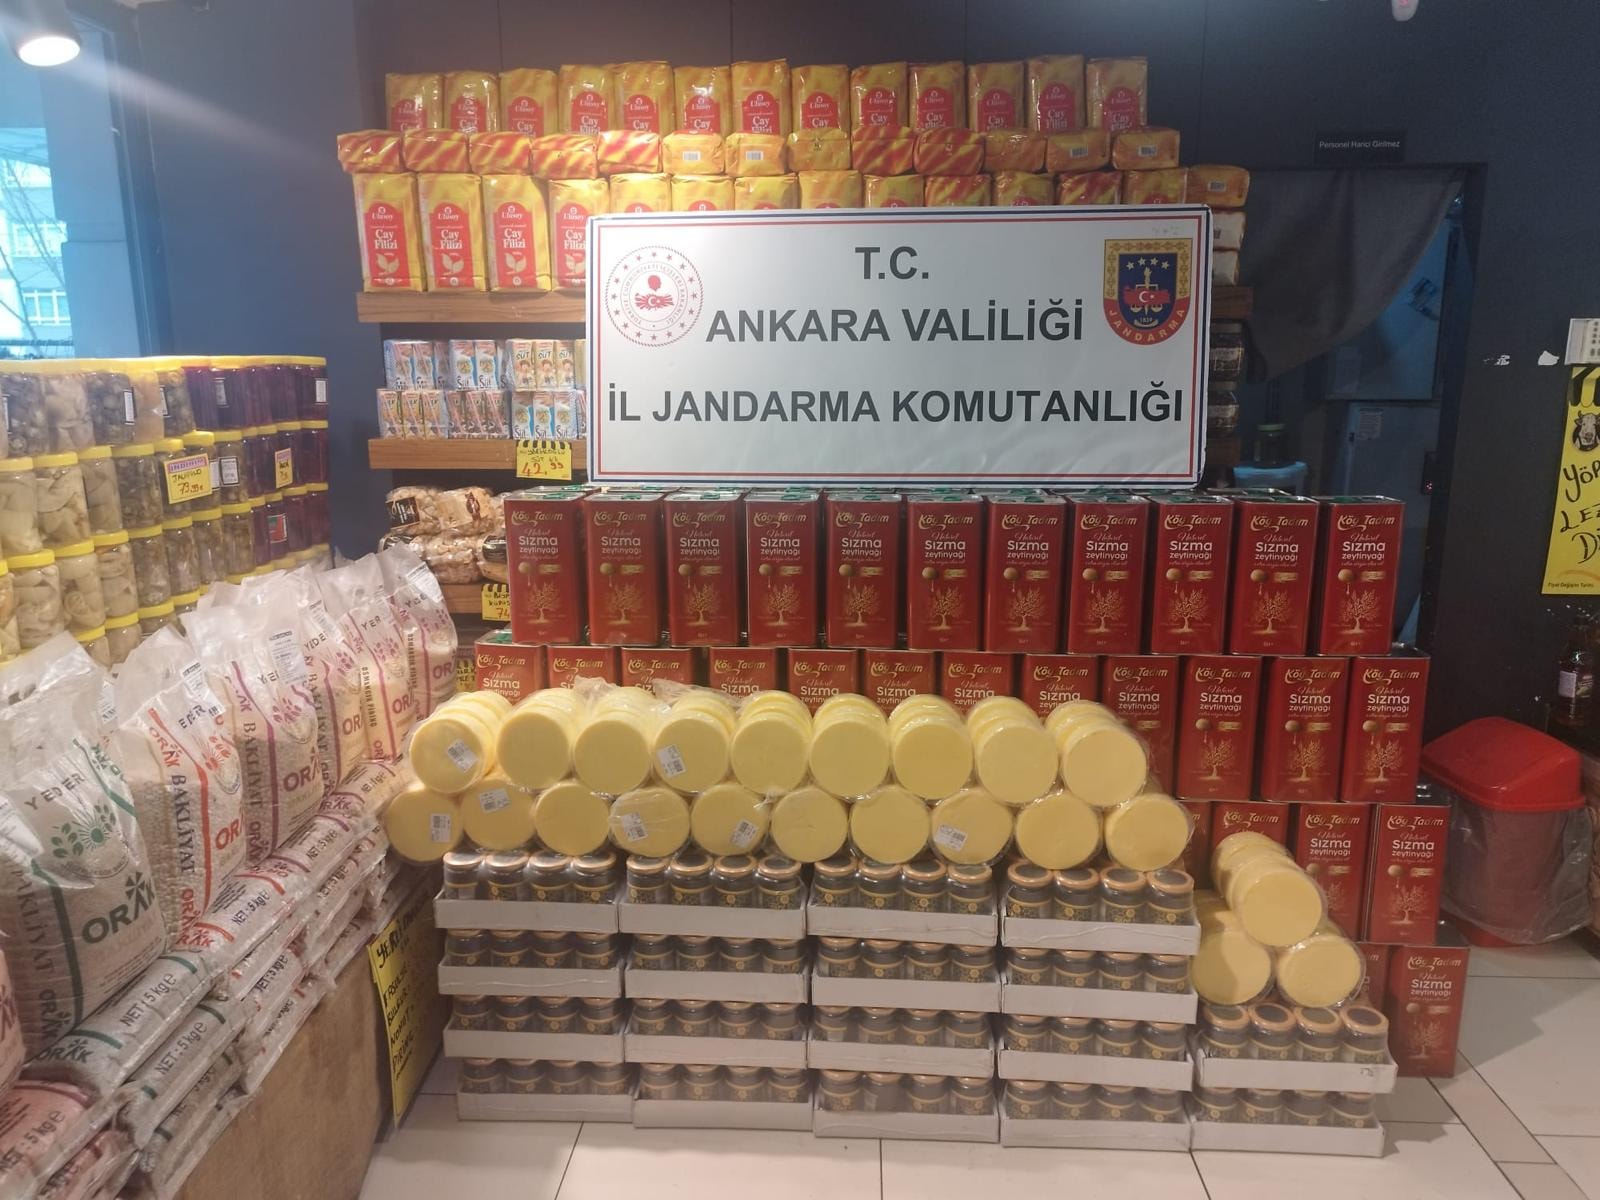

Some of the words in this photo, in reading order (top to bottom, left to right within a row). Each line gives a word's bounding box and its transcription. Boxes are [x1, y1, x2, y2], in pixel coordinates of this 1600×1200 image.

[375, 228, 393, 241] Çay
[441, 229, 459, 241] Çay
[504, 228, 522, 240] Çay
[565, 229, 584, 241] Çay
[374, 239, 398, 249] Filizi
[440, 239, 463, 249] Filizi
[503, 238, 526, 249] Filizi
[855, 246, 929, 280] T.C.
[705, 309, 891, 342] ANKARA
[901, 298, 1083, 342] VALİLİĞİ
[1109, 309, 1185, 342] JANDARMA
[609, 383, 641, 421] İL
[652, 390, 881, 422] JANDARMA
[892, 381, 1183, 422] KOMUTANLIĞI
[519, 536, 558, 545] Sızma
[601, 536, 641, 546] Sızma
[680, 537, 719, 547] Sızma
[760, 537, 800, 547] Sızma
[841, 538, 882, 548] Sızma
[924, 540, 966, 550] Sızma
[519, 545, 558, 554] zeytinyağı
[602, 546, 641, 555] zeytinyağı
[1007, 541, 1049, 551] Sızma
[1086, 541, 1128, 551] Sızma
[1170, 541, 1213, 551] Sızma
[1256, 542, 1299, 553] Sızma
[1343, 541, 1386, 552] Sızma
[680, 547, 720, 556] zeytinyağı
[760, 547, 800, 556] zeytinyağı
[841, 548, 882, 557] zeytinyağı
[924, 550, 966, 559] zeytinyağı
[1007, 551, 1048, 560] zeytinyağı
[1086, 551, 1128, 560] zeytinyağı
[1169, 552, 1212, 560] zeytinyağı
[1342, 552, 1385, 561] zeytinyağı
[1255, 553, 1298, 561] zeytinyağı
[483, 678, 520, 689] Sızma
[801, 686, 839, 696] Sızma
[877, 686, 916, 697] Sızma
[1039, 691, 1081, 700] Sızma
[1119, 692, 1160, 702] Sızma
[1200, 692, 1242, 703] Sızma
[1289, 693, 1331, 704] Sızma
[1367, 694, 1410, 704] Sızma
[1119, 702, 1160, 711] zeytinyağı
[1200, 703, 1241, 712] zeytinyağı
[1289, 704, 1331, 713] zeytinyağı
[1367, 705, 1409, 713] zeytinyağı
[284, 746, 320, 793] ORA
[171, 774, 195, 873] BAKLİYAT
[1310, 838, 1351, 848] Sızma
[1392, 839, 1435, 850] Sızma
[1309, 848, 1350, 857] zeytinyağı
[1391, 850, 1434, 858] zeytinyağı
[1411, 979, 1451, 989] Sızma
[1411, 989, 1451, 998] zeytinyağı
[120, 1002, 145, 1027] NET
[154, 1052, 178, 1076] NET
